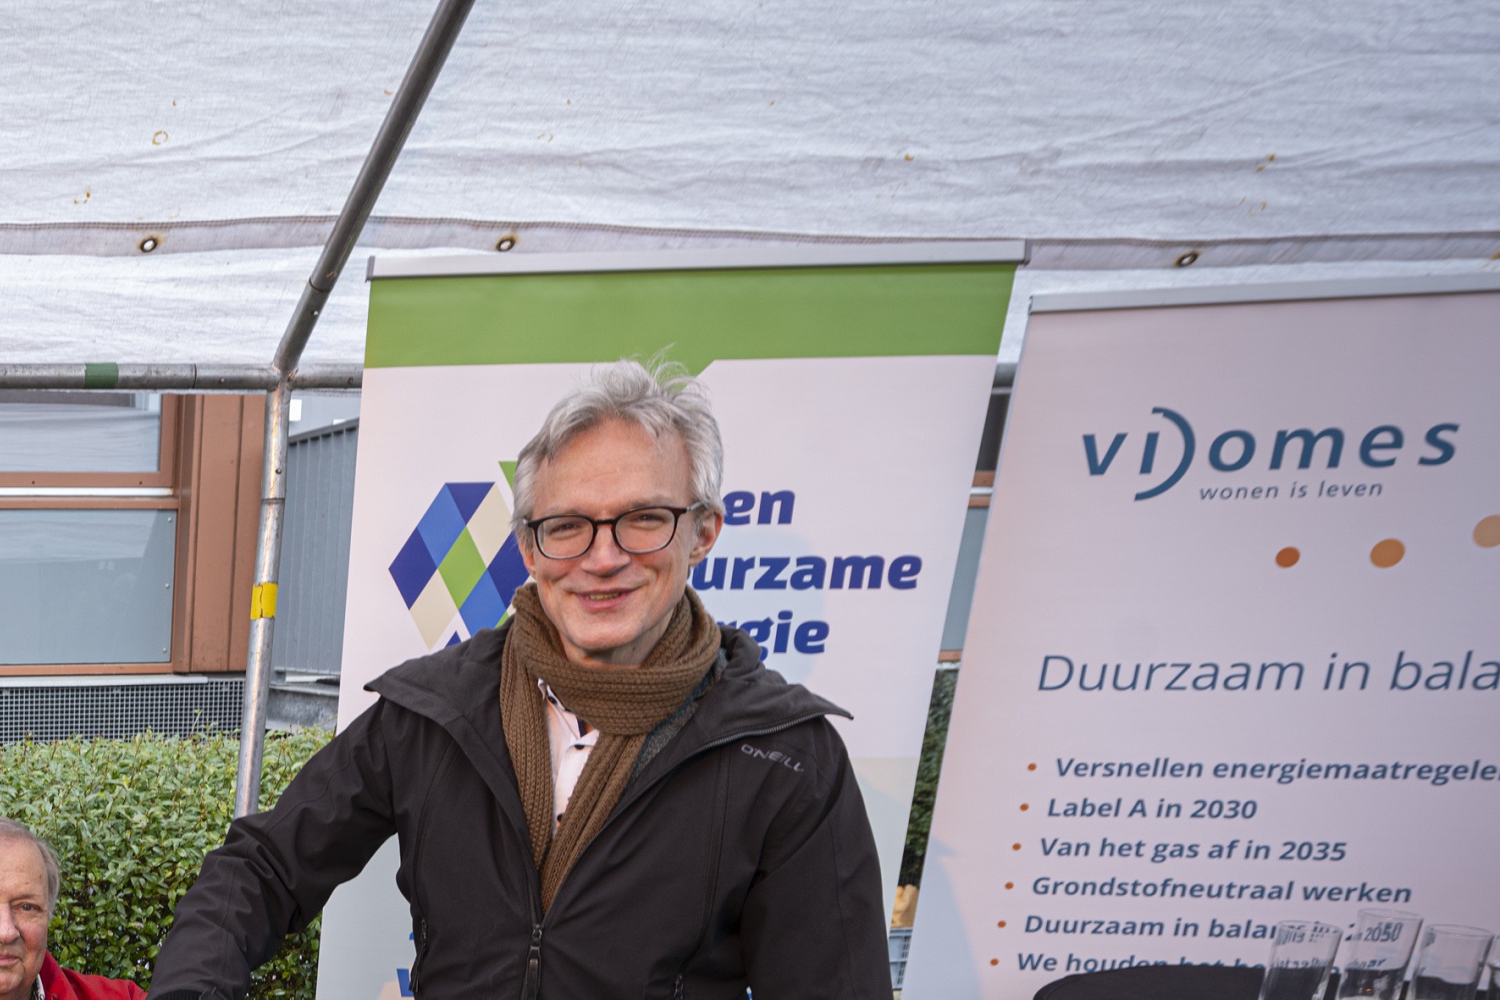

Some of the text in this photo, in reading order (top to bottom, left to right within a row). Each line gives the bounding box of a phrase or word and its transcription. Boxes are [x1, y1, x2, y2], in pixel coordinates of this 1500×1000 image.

[1199, 481, 1383, 501] wonen is leven
[722, 490, 796, 526] en
[690, 554, 922, 591] urzame
[716, 610, 830, 662] gie
[1037, 655, 1305, 692] Duurzaam
[1322, 652, 1371, 691] in
[1056, 757, 1203, 779] Versnellen
[1047, 797, 1258, 820] Label A in 2030
[1040, 837, 1347, 864] Van het gas af in 2035
[1032, 876, 1412, 904] Grondstofneutraal werken
[1024, 915, 1164, 937] Duurzaam
[1173, 917, 1199, 938] in
[1017, 952, 1058, 971] We
